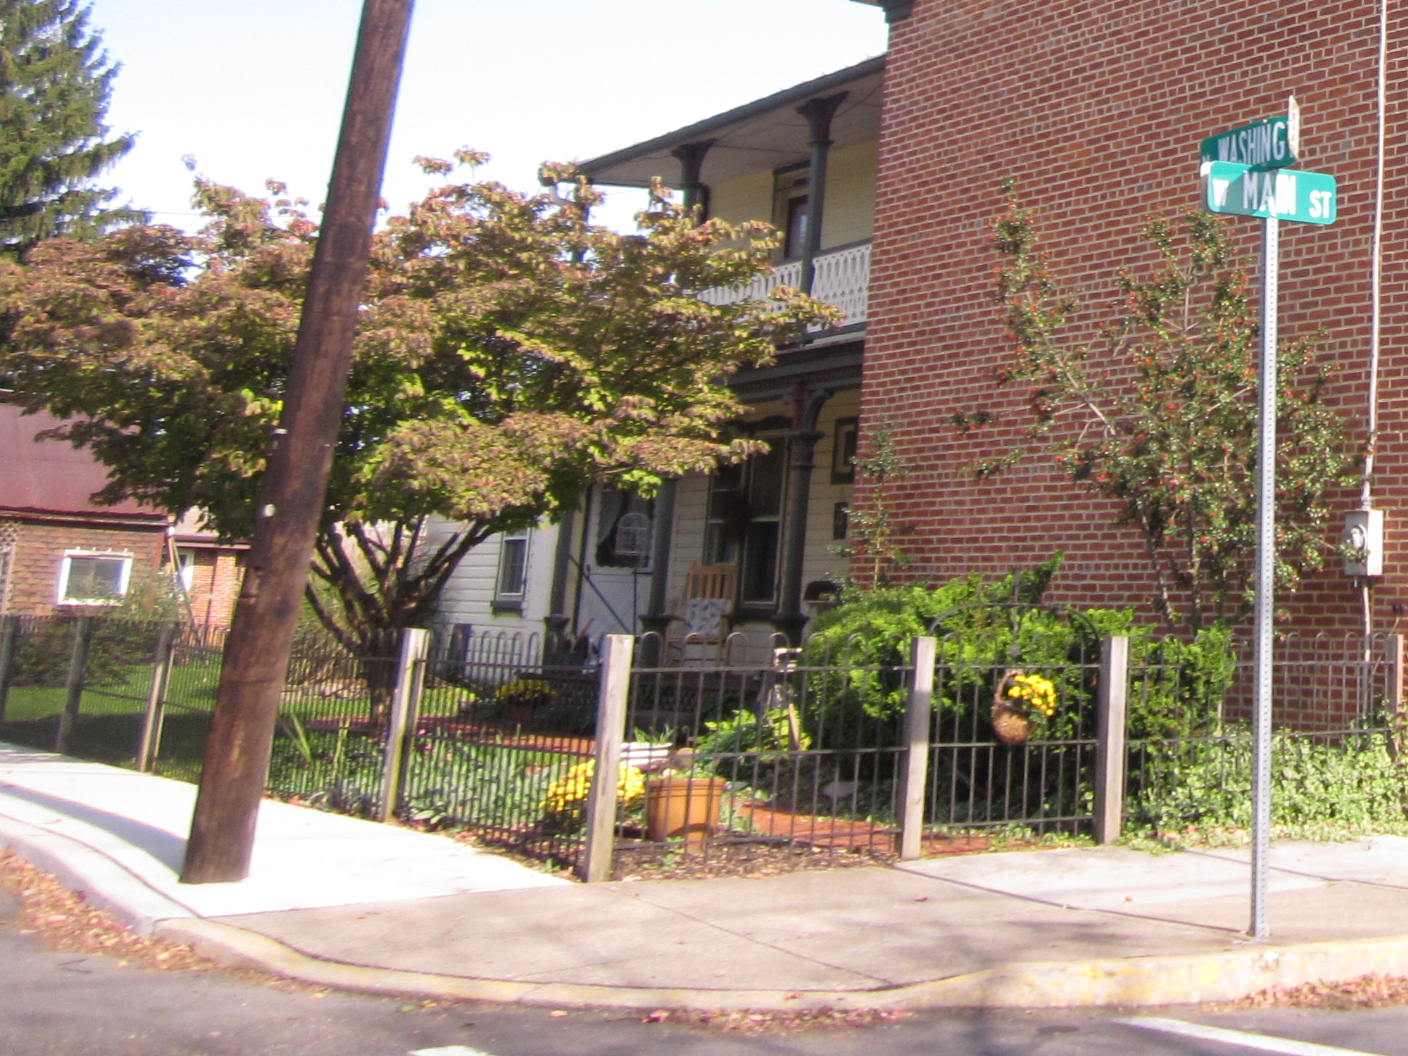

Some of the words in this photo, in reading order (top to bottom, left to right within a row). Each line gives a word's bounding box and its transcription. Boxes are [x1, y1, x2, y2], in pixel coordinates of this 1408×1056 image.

[1218, 121, 1293, 165] WASHING
[1212, 179, 1229, 207] W
[1243, 171, 1296, 215] MAIN
[1308, 190, 1332, 218] ST
